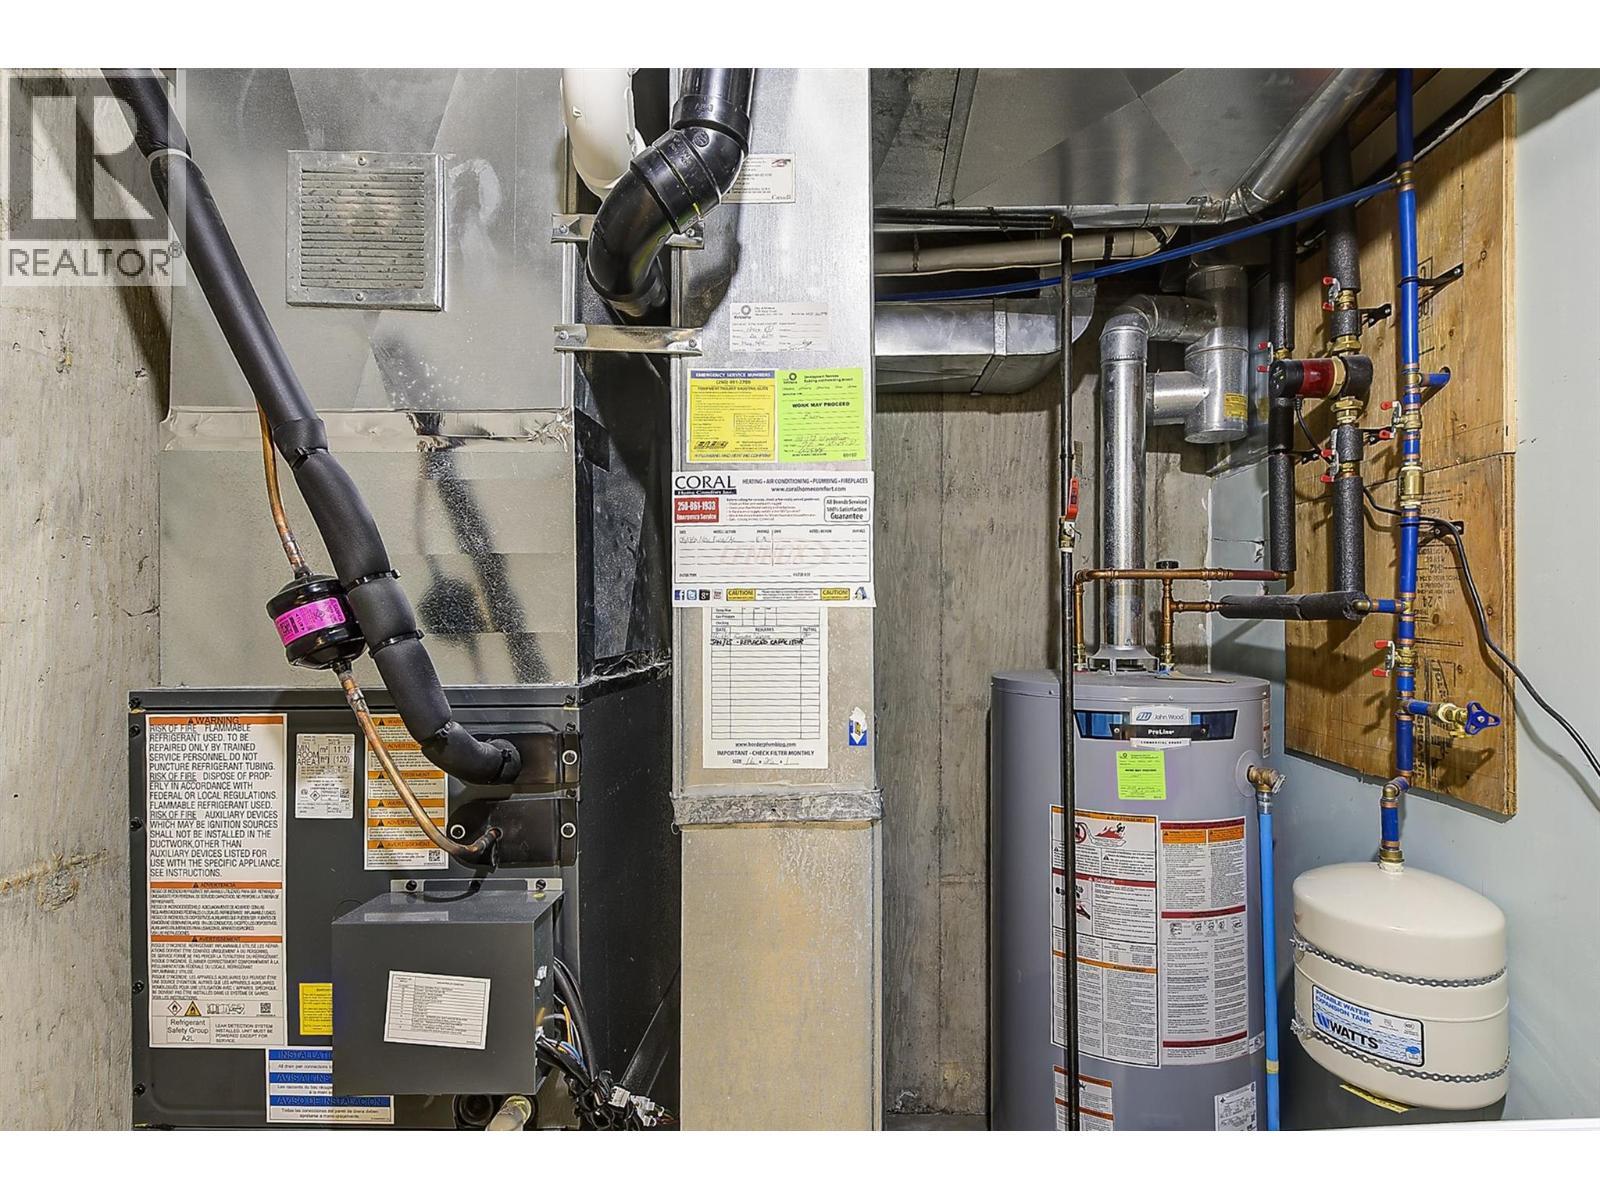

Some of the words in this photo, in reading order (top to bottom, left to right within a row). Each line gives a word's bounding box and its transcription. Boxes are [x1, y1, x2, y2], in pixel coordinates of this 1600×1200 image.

[674, 475, 736, 490] CORAL
[830, 512, 864, 520] Guarantee
[196, 716, 240, 724] WARNING
[150, 724, 168, 732] RISK
[168, 724, 178, 732] OF
[204, 724, 252, 732] FLAMMABLE
[150, 732, 200, 742] REFRIGERANT
[227, 732, 238, 742] TO
[240, 732, 250, 742] BE
[150, 742, 186, 752] REPAIRED
[188, 742, 210, 752] ONLY
[210, 742, 220, 752] BY
[223, 742, 256, 752] TRAINED
[150, 752, 180, 762] SERVICE
[242, 752, 258, 762] NOT
[150, 762, 190, 772] PUNCTURE
[192, 762, 244, 772] REFRIGERANT
[150, 772, 166, 780] RISK
[168, 772, 178, 780] OF
[202, 772, 236, 780] DISPOSE
[237, 772, 248, 780] OF
[150, 782, 168, 790] ERLY
[170, 782, 179, 790] IN
[180, 782, 232, 790] ACCORDANCE
[233, 782, 254, 790] WITH
[150, 791, 184, 800] FEDERAL
[184, 791, 196, 800] OR
[196, 791, 220, 800] LOCAL
[150, 800, 196, 810] FLAMMABLE
[197, 800, 248, 810] REFRIGERANT
[150, 810, 168, 820] RISK
[168, 810, 178, 820] OF
[205, 810, 246, 820] AUXILIARY
[246, 810, 278, 820] DEVICES
[150, 820, 176, 829] WHICH
[177, 820, 194, 829] MAY
[196, 820, 206, 829] BE
[207, 820, 240, 829] IGNITION
[242, 820, 278, 829] SOURCES
[150, 830, 174, 838] SHALL
[176, 830, 192, 838] NOT
[192, 830, 202, 838] BE
[204, 830, 246, 838] INSTALLED
[246, 830, 256, 838] IN
[256, 830, 272, 838] THE
[222, 840, 242, 848] THAN
[150, 849, 190, 858] AUXILIARY
[190, 849, 222, 858] DEVICES
[224, 849, 250, 858] LISTED
[252, 849, 268, 858] FOR
[150, 859, 165, 868] USE
[166, 859, 186, 868] WITH
[188, 859, 202, 868] THE
[204, 859, 238, 868] SPECIFIC
[150, 868, 164, 878] SEE
[1315, 990, 1342, 1007] POTABLE
[1342, 1002, 1370, 1018] WATER
[1315, 996, 1350, 1017] EXPANSION
[1350, 1012, 1372, 1025] TANK
[170, 1018, 206, 1027] Refrigerant
[166, 1026, 188, 1034] Safety
[188, 1026, 209, 1034] Group
[1328, 1018, 1379, 1050] WATTS
